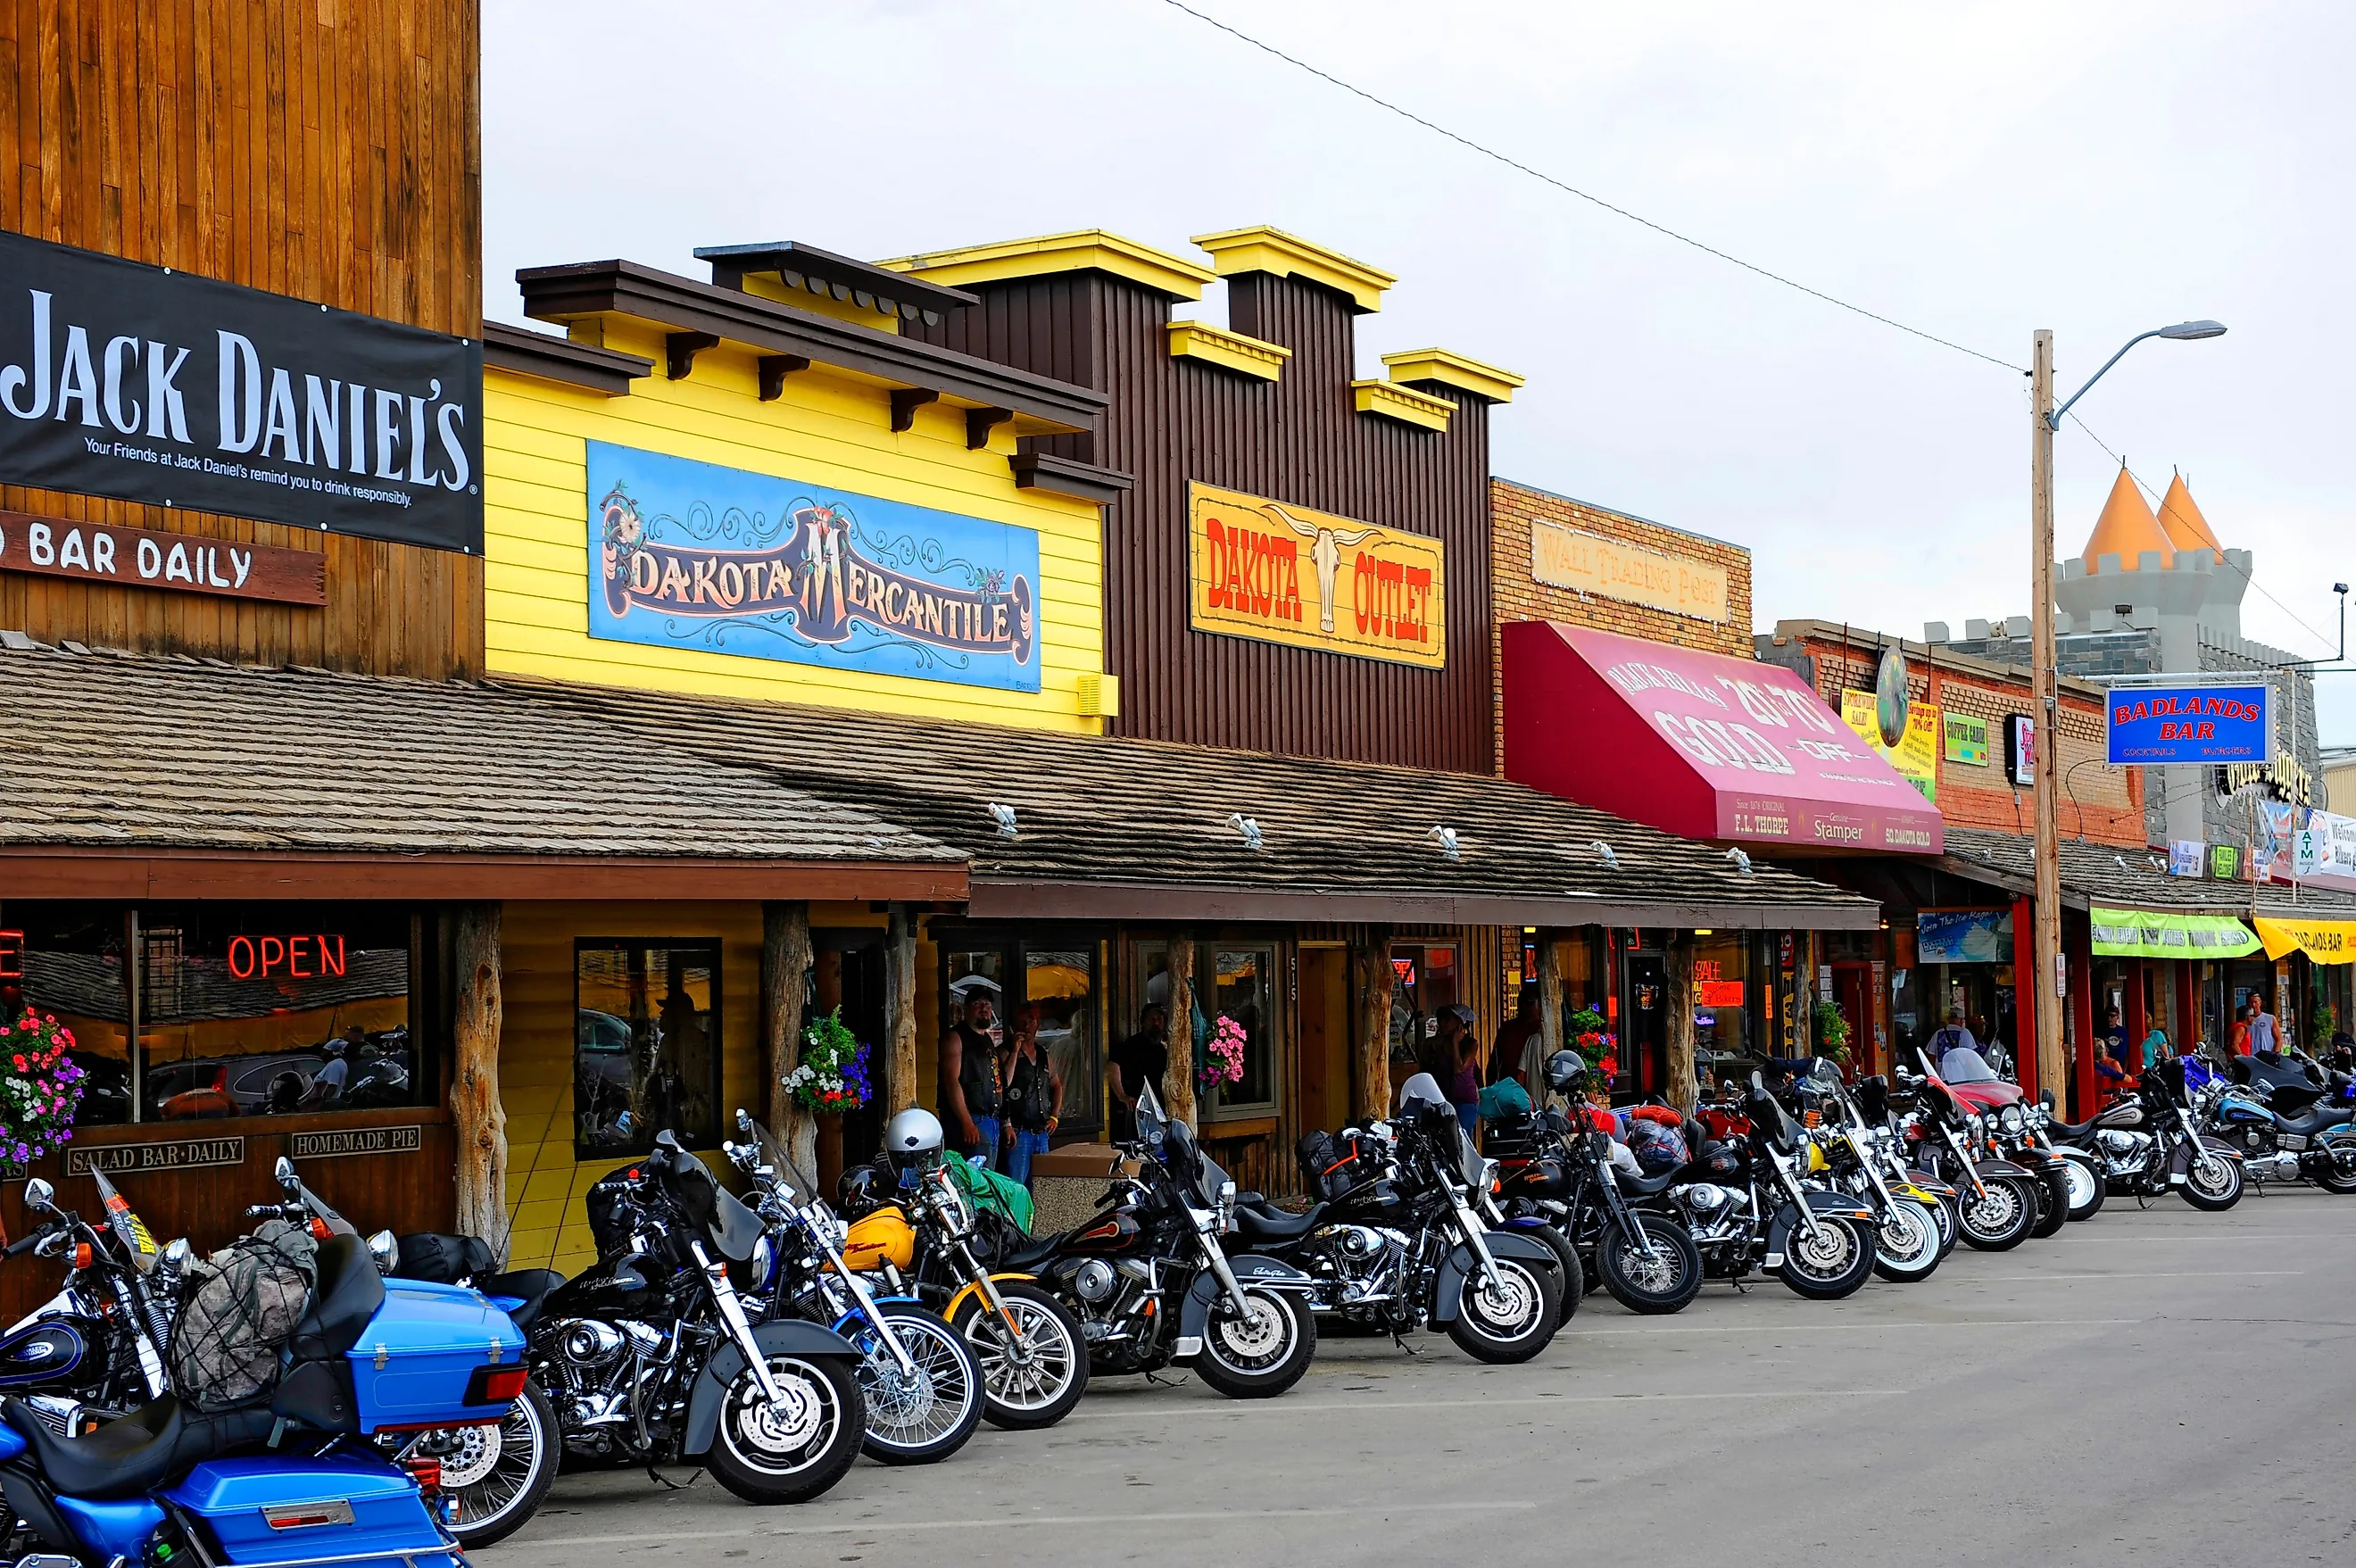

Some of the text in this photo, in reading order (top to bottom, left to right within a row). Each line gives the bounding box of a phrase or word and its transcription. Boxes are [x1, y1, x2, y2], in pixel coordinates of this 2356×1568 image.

[0, 288, 470, 491] JACK DANIEL'S
[84, 436, 412, 509] Your Friends at Jack Daniel's remind you to drink responsibly.
[29, 522, 117, 576] BAR
[137, 538, 252, 590] DAILY
[1540, 531, 1718, 604] WALL TRADING POST
[628, 522, 1014, 643] DAKOTA MERCANTILE
[1207, 518, 1431, 643] DAKOTA OUTLET
[1606, 661, 1730, 710] BLACK HILLS
[2114, 696, 2261, 726] BADLANDS
[1653, 710, 1796, 776] GOLD
[2158, 721, 2215, 741] BAR
[2122, 746, 2252, 757] COCKTAILS BURGERS
[1734, 813, 1789, 835] F.L. THORPE
[1814, 818, 1863, 843] Stamper
[1829, 812, 1849, 823] Genuine
[2301, 831, 2313, 859] ATM
[1920, 922, 1937, 934] Join
[1939, 915, 1955, 927] The
[228, 935, 345, 979] OPEN
[2327, 933, 2343, 952] BAR
[1695, 960, 1721, 981] SALE
[72, 1141, 239, 1173] SALAD BAR DAILY
[296, 1128, 417, 1156] HOMEMADE PIE
